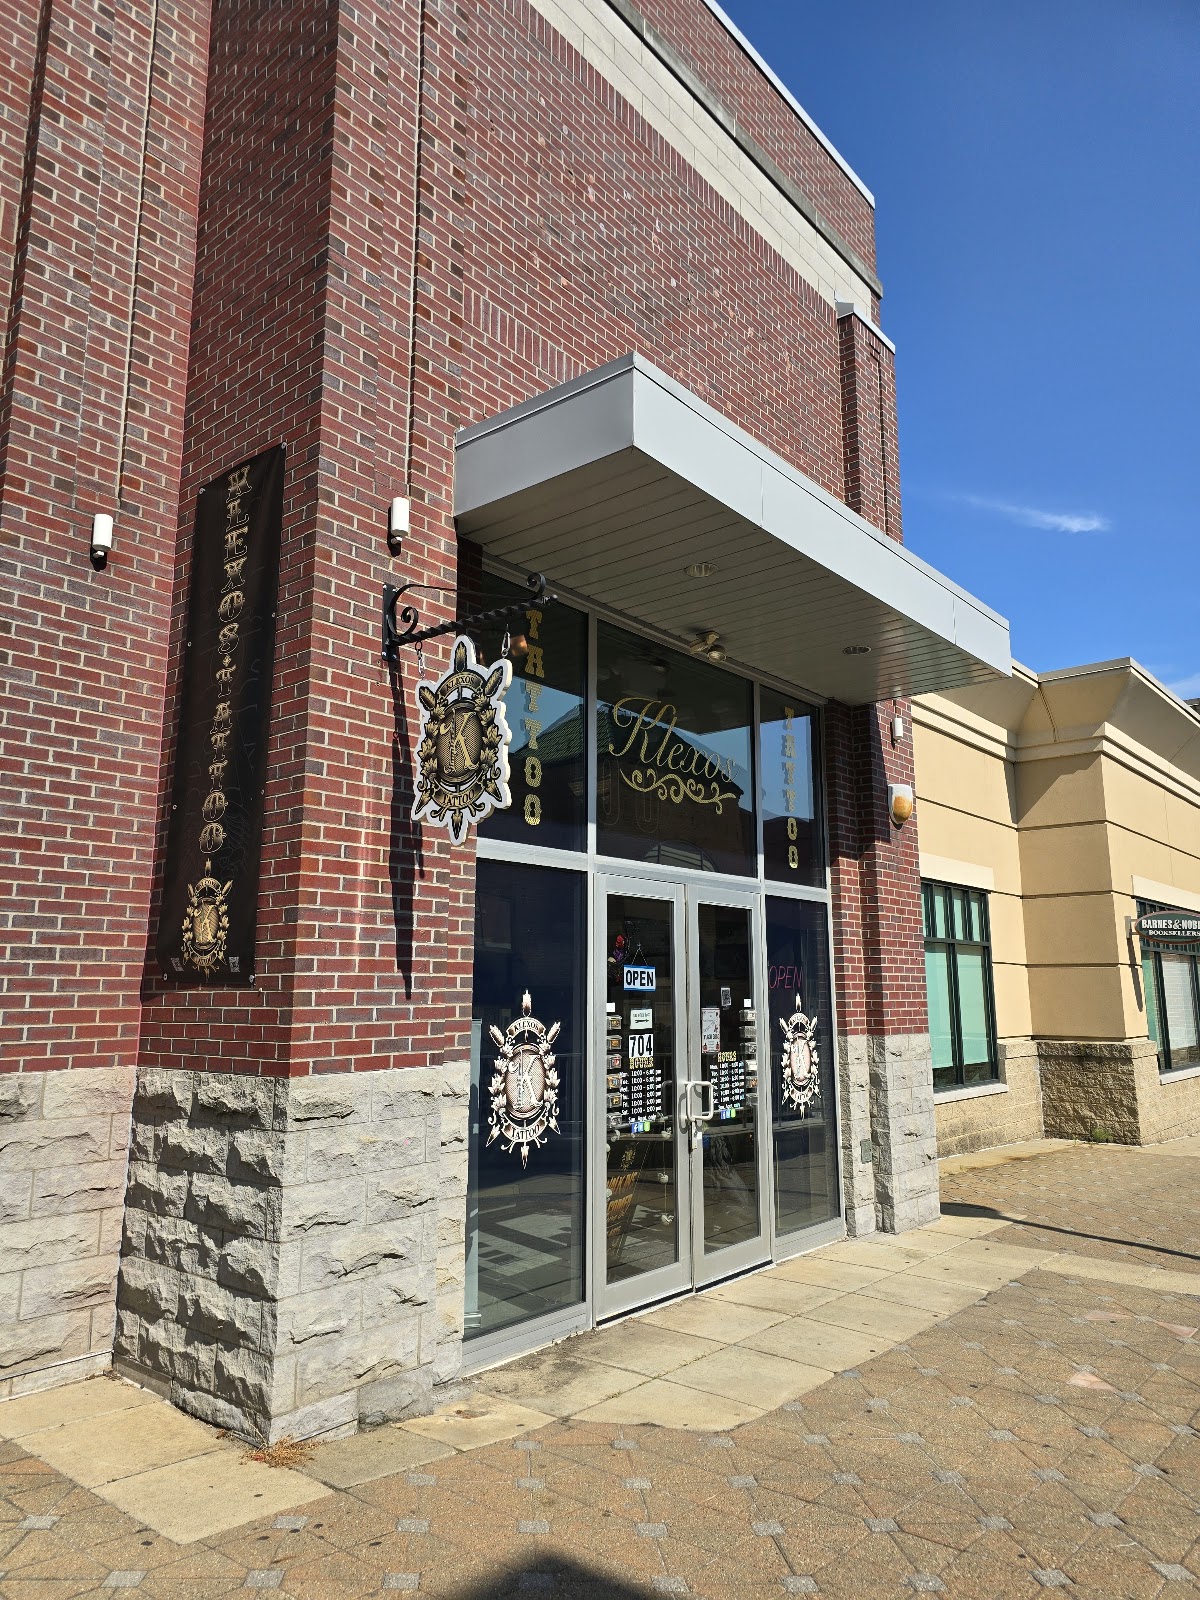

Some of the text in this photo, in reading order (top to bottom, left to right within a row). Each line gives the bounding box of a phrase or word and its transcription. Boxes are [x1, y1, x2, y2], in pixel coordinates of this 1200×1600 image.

[524, 609, 545, 826] TATTOO
[609, 697, 740, 782] Klexos
[443, 789, 475, 806] TATTOO
[626, 969, 654, 987] OPEN
[769, 965, 803, 989] OPEN
[630, 1034, 653, 1058] 704
[511, 1124, 540, 1141] TATTOO
